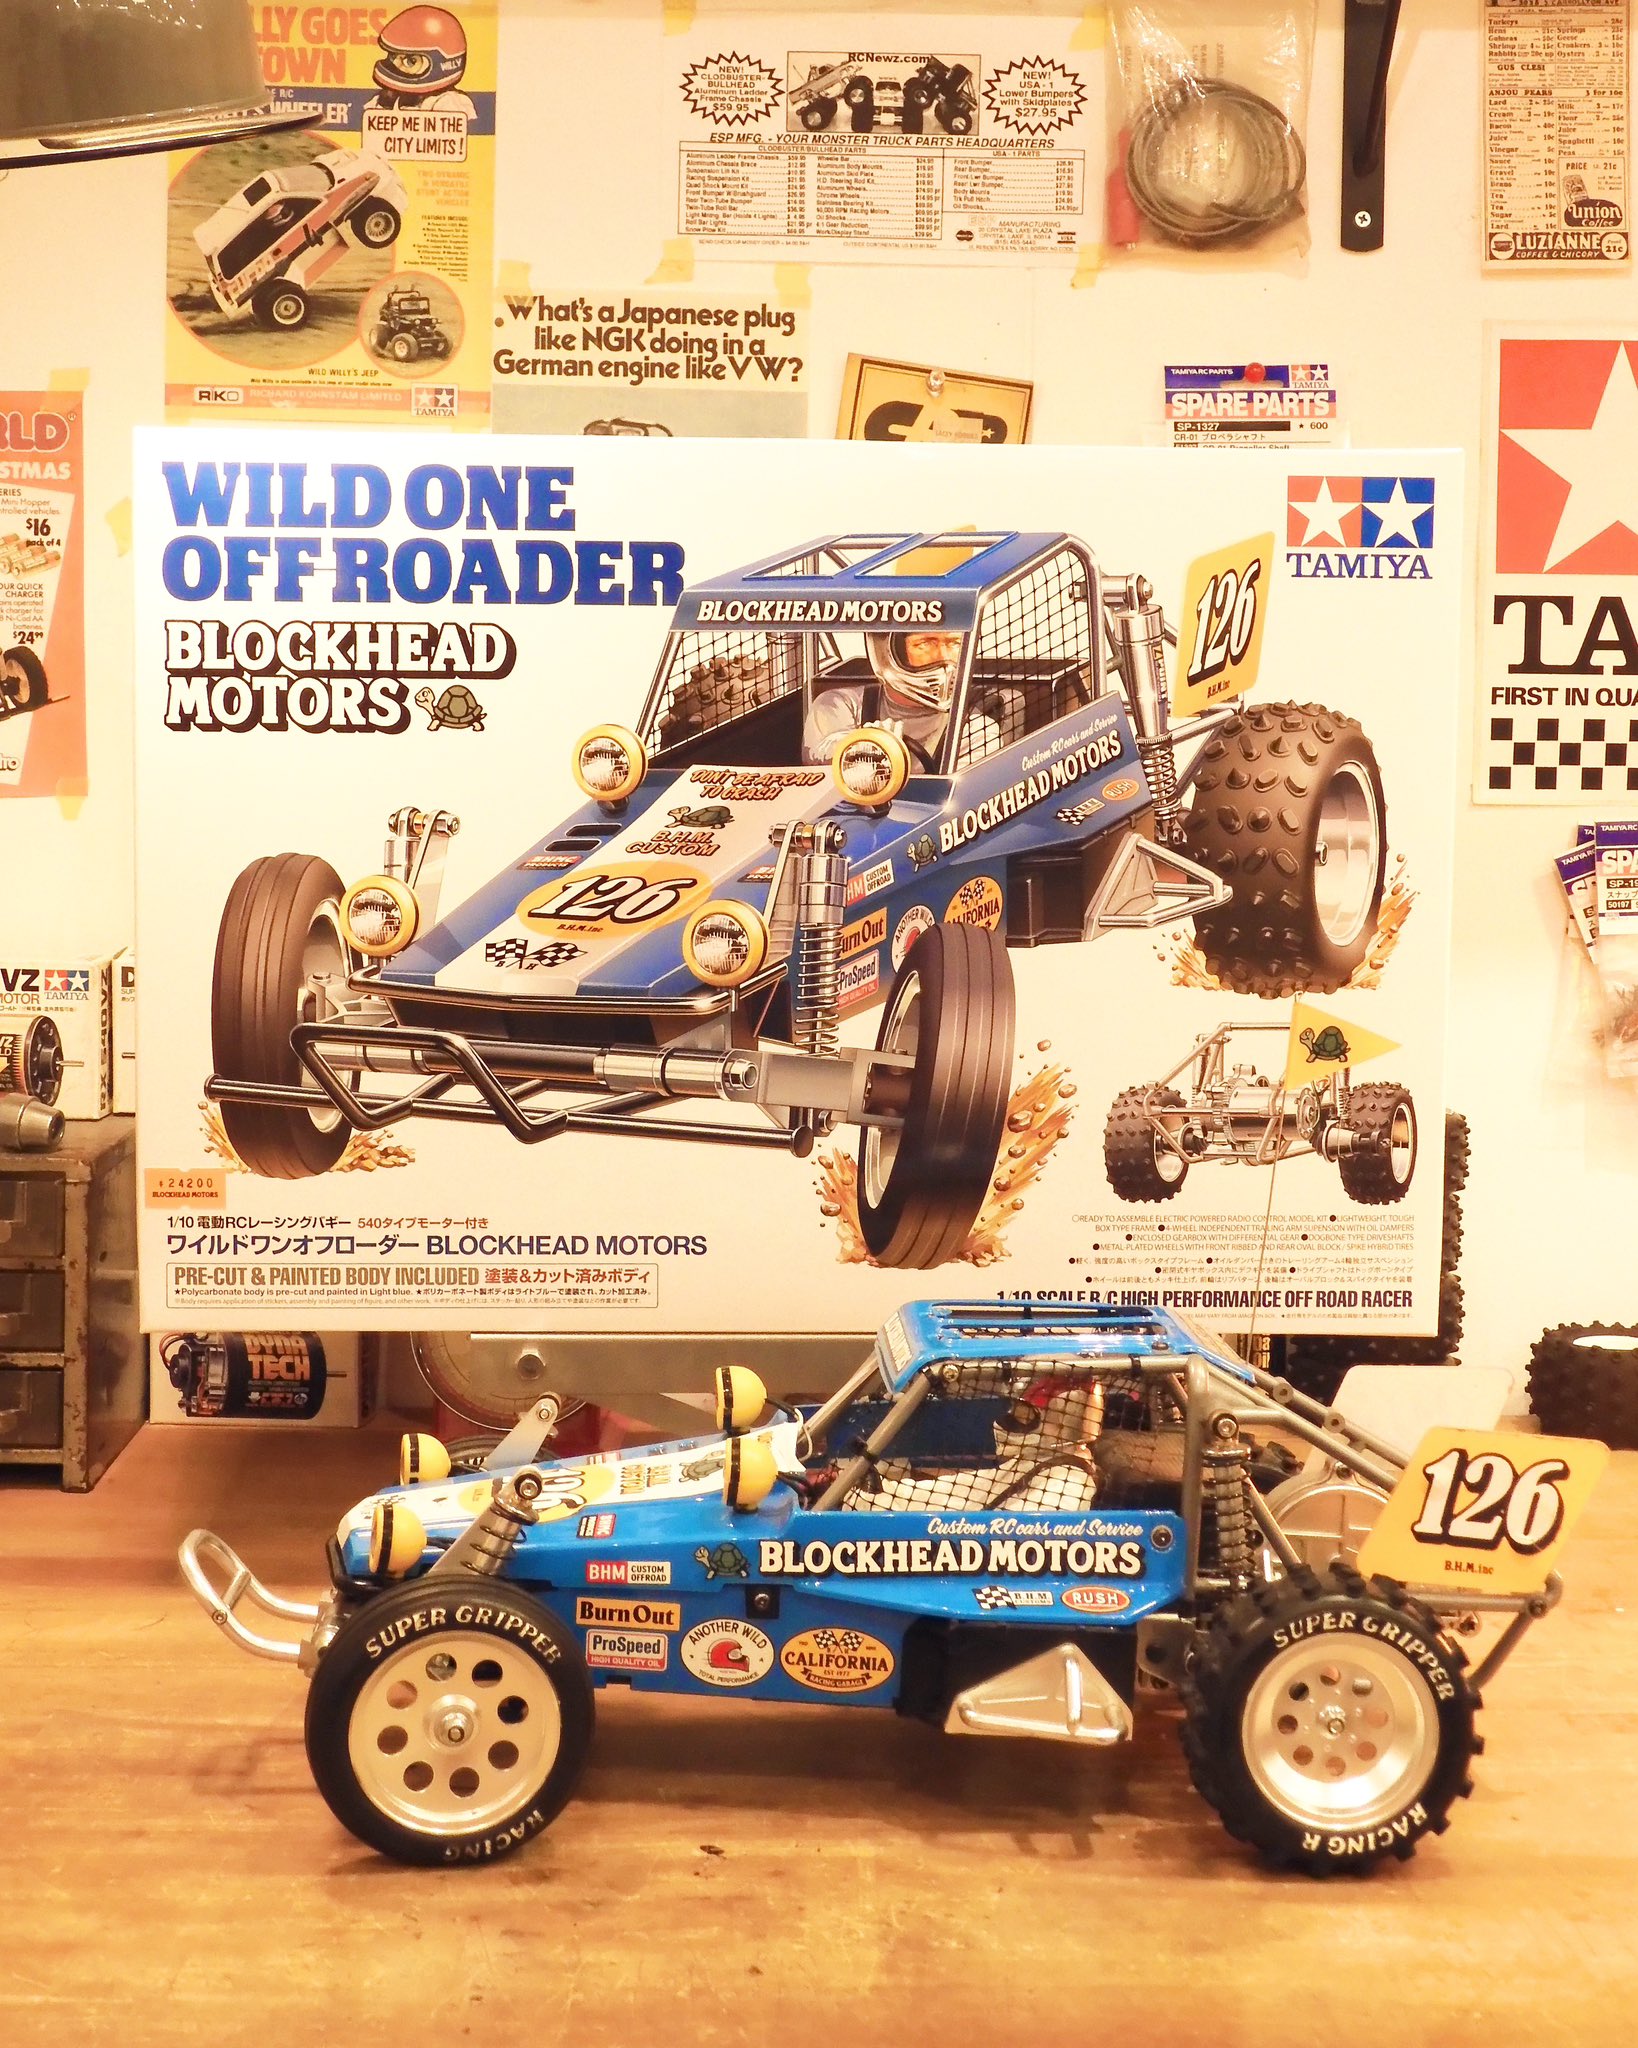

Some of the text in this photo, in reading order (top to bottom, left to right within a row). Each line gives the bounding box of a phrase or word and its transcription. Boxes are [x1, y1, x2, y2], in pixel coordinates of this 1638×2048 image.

[301, 7, 387, 46] GOES
[848, 52, 931, 64] RCNewz.com
[1023, 71, 1051, 80] NEW!
[694, 88, 769, 97] Aluminum Ladder
[708, 81, 756, 89] BULLHEAD
[1019, 81, 1040, 89] USA
[999, 89, 1076, 100] Lower Bumpers
[1000, 98, 1073, 108] with Skidplates
[1015, 108, 1058, 118] $27.95
[368, 115, 463, 133] KEEP ME IN THE
[384, 137, 456, 155] CITY LIMITS
[710, 132, 1056, 149] ESP MFG. YOUR MONSTER TRUCK PARTS HEADQUARTERS
[1566, 162, 1588, 170] PRICE
[1513, 231, 1601, 250] LUZIANNE
[1515, 251, 1600, 259] COFFEE CHICORY
[503, 295, 796, 336] What's a Japanese plug
[534, 325, 766, 363] like NGK doing in a
[492, 348, 727, 387] German engine like
[1170, 368, 1233, 376] TAMIYA PARTS
[415, 408, 456, 417] TAMIYA
[1171, 391, 1330, 418] SPARE PARTS
[1176, 421, 1328, 431] SP-1327 600
[1174, 433, 1266, 441] CR-01 プロペラシャフト
[20, 498, 50, 508] Hopper
[161, 460, 577, 532] WILD ONE
[26, 518, 51, 537] $16
[26, 539, 44, 548] pack
[161, 533, 687, 607] OFF-ROADER
[1285, 552, 1434, 580] TAMIYA
[5, 590, 44, 598] CHARGER
[696, 600, 943, 623] BLOCKHEAD MOTORS
[1186, 557, 1262, 688] 126
[164, 619, 518, 681] BLOCKHEAD
[164, 675, 413, 735] MOTORS
[1491, 686, 1589, 706] FIRST IN
[1021, 750, 1051, 772] Custom
[690, 768, 826, 787] DON'T BE AFRAID
[699, 784, 784, 801] TO CRASH
[938, 728, 1123, 854] BLOCKHEAD MOTORS
[625, 843, 721, 857] CUSTOM
[865, 865, 889, 882] CUSTOM
[866, 873, 892, 892] OFFROAD
[526, 874, 698, 925] 126
[1607, 901, 1630, 910] 50197
[45, 992, 89, 1001] TAMIYA
[152, 1191, 218, 1199] BLOCKHEAD MOTORS
[196, 1215, 489, 1230] 電動RCレーシングバギー 540タイプモーター付き
[1104, 1214, 1227, 1223] TO ASSEMBLE ELECTRIC POWERED
[166, 1233, 708, 1257] ワイルドワンオフローダー BLOCKHEAD MOTORS
[1132, 1233, 1208, 1242] ENCLOSED GEARBOX
[1347, 1233, 1415, 1242] TYPE DRIVESHAFTS
[1155, 1243, 1257, 1252] WHEELS WITH FRONT RIBBED
[174, 1266, 651, 1287] PRE-CUT & PAINTED BODY INCLUDED 塗装&カット済みボディ
[181, 1287, 413, 1298] Polycarbonate body is pre-cut and painted in Light blue.
[1120, 1290, 1414, 1308] HIGH PERFORMANCE OFF ROAD RACER
[247, 1353, 311, 1381] TECH
[1410, 1447, 1571, 1557] 126
[926, 1518, 1144, 1537] Custom RC and Service
[758, 1539, 1148, 1577] BLOCKHEAD MOTORS
[588, 1564, 665, 1581] BHM CUSTOM
[630, 1573, 668, 1583] OFFROAD
[1071, 1591, 1119, 1606] RUSH
[365, 1604, 562, 1664] SUPER GRIPPER
[687, 1620, 768, 1650] ANOTHER WILD
[591, 1634, 661, 1657] ProSpeed
[590, 1656, 662, 1668] HIGH QUALITY OIL
[783, 1650, 889, 1673] CALIFORNIA
[1272, 1611, 1455, 1700] SUPER GRIPPER
[1326, 1801, 1429, 1855] RACING
